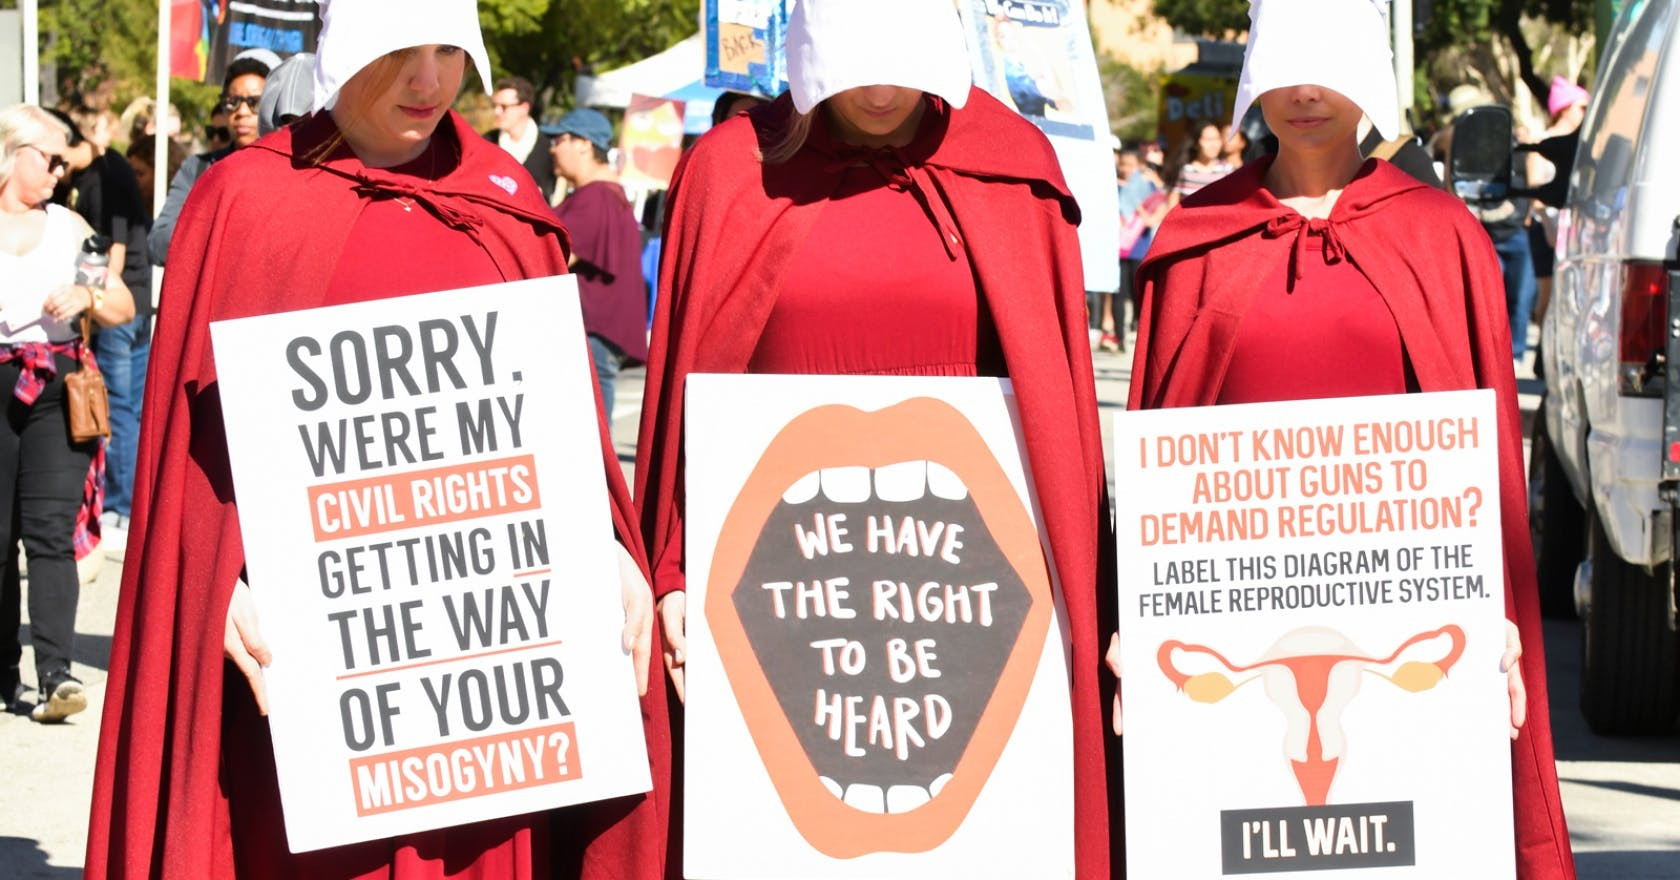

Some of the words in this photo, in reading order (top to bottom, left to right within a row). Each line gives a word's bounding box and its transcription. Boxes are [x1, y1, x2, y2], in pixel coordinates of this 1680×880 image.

[1167, 92, 1224, 121] Deli
[298, 407, 444, 477] WERE
[456, 394, 523, 455] MY
[1141, 438, 1146, 468] I
[1157, 432, 1243, 467] DON'T
[1253, 425, 1343, 461] KNOW
[1354, 418, 1478, 455] ENOUGH
[317, 485, 404, 532] CIVIL
[412, 465, 532, 518] RIGHTS
[1193, 467, 1290, 504] ABOUT
[1300, 462, 1382, 497] GUNS
[1391, 459, 1427, 491] TO
[796, 514, 853, 559] WE
[869, 516, 964, 564] HAVE
[1141, 508, 1268, 546] DEMAND
[1278, 487, 1482, 537] REGULATION?
[318, 528, 495, 598] GETTING
[508, 519, 549, 569] IN
[1154, 560, 1220, 585] LABEL
[1226, 556, 1276, 580] THIS
[1285, 549, 1389, 577] DIAGRAM
[1397, 548, 1424, 571] OF
[1431, 545, 1472, 569] THE
[763, 578, 856, 618] THE
[874, 581, 997, 626] RIGHT
[1140, 590, 1222, 616] FEMALE
[1230, 580, 1392, 612] REPRODUCTIVE
[1400, 575, 1489, 602] SYSTEM.
[328, 600, 431, 669] THE
[443, 580, 549, 650] WAY
[811, 639, 865, 675] TO
[888, 639, 941, 683] BE
[340, 683, 400, 751] OF
[420, 658, 570, 736] YOUR
[816, 690, 952, 760] HEARD
[358, 732, 569, 808] MISOGYNY?
[1243, 820, 1295, 858] I'LL
[1304, 815, 1395, 855] WAIT.
